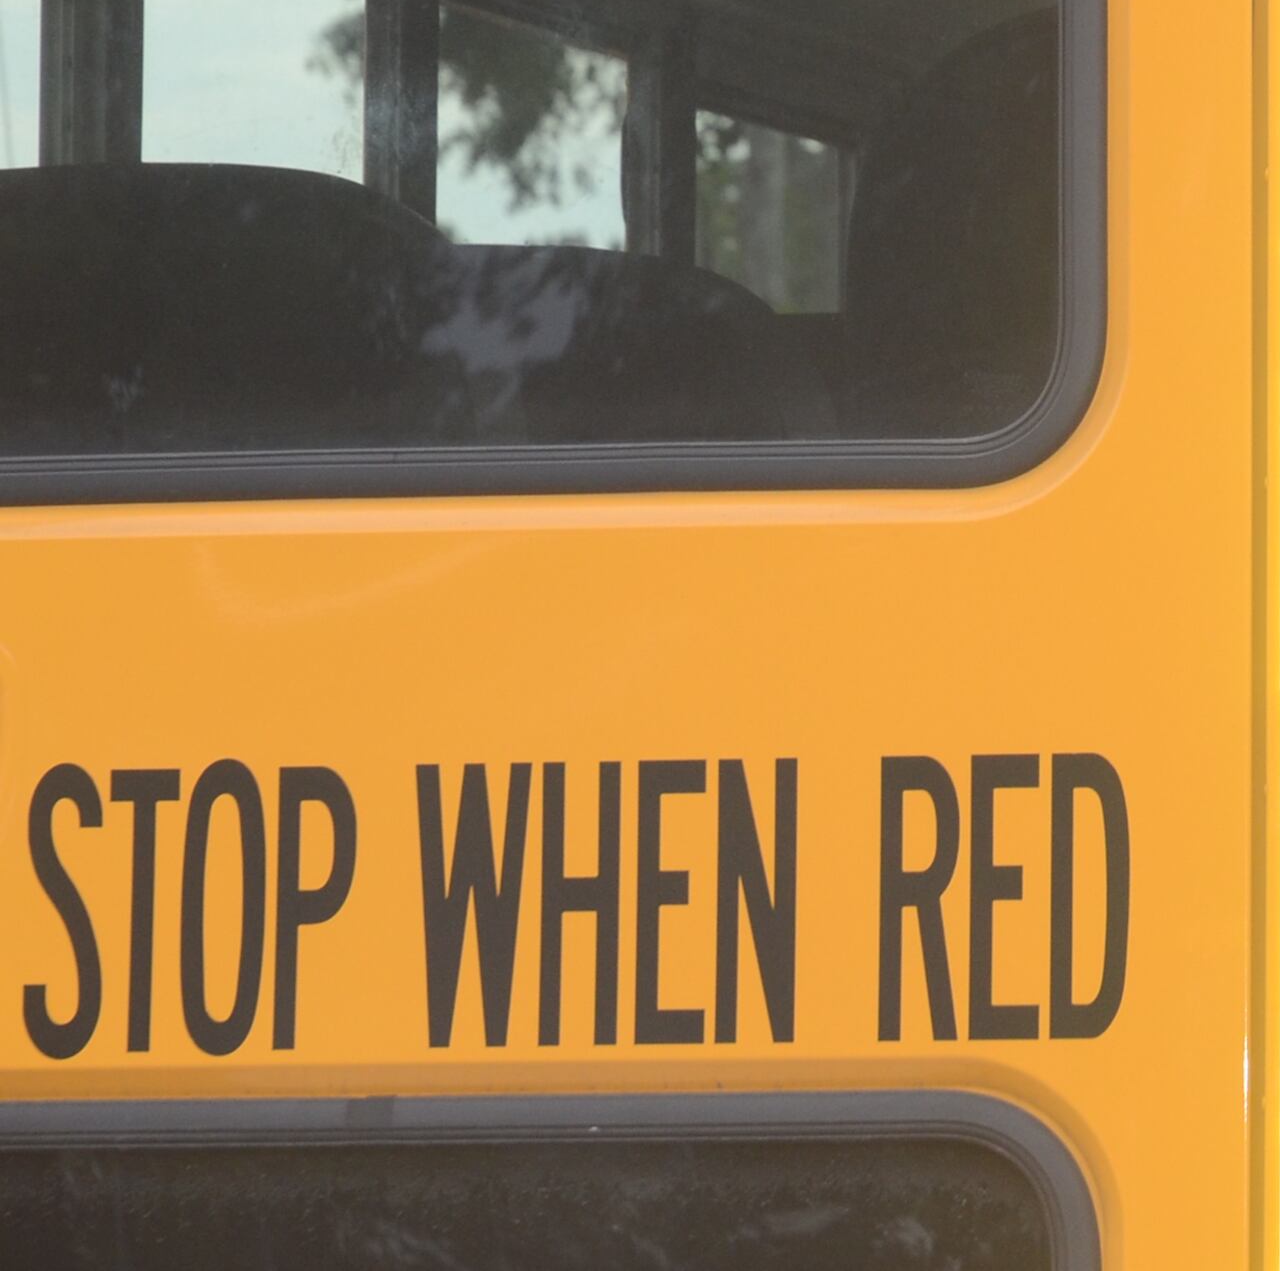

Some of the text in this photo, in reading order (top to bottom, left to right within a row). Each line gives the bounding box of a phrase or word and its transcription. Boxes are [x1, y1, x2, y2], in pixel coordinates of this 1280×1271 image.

[23, 753, 1130, 1060] STOP WHEN RED
